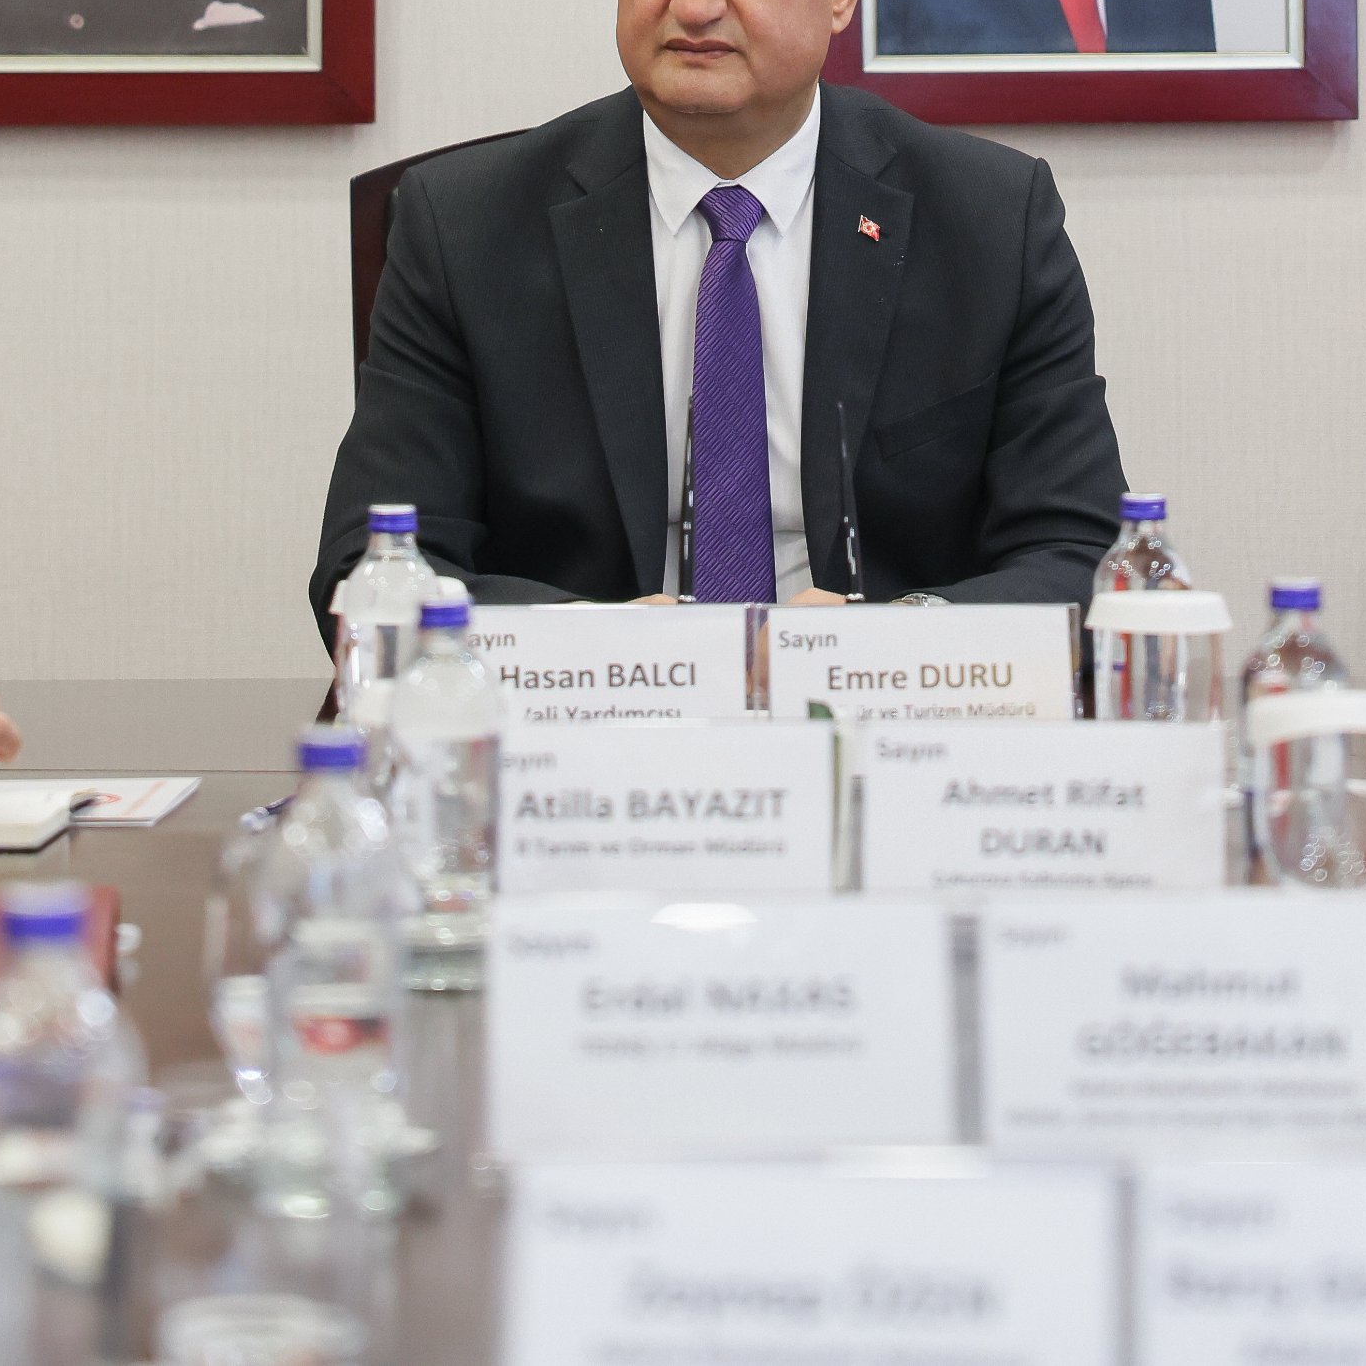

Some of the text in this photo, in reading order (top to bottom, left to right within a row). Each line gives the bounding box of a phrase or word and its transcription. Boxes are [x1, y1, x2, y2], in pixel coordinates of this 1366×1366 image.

[467, 633, 516, 650] ayın
[778, 630, 838, 651] Sayın
[500, 662, 696, 689] Hasan BALCI
[828, 662, 1013, 690] Emre DURU
[525, 705, 558, 720] ali
[501, 753, 557, 772] ayın
[516, 789, 614, 819] Atilla
[942, 779, 1054, 806] Ahmet
[981, 829, 1107, 855] DURAN
